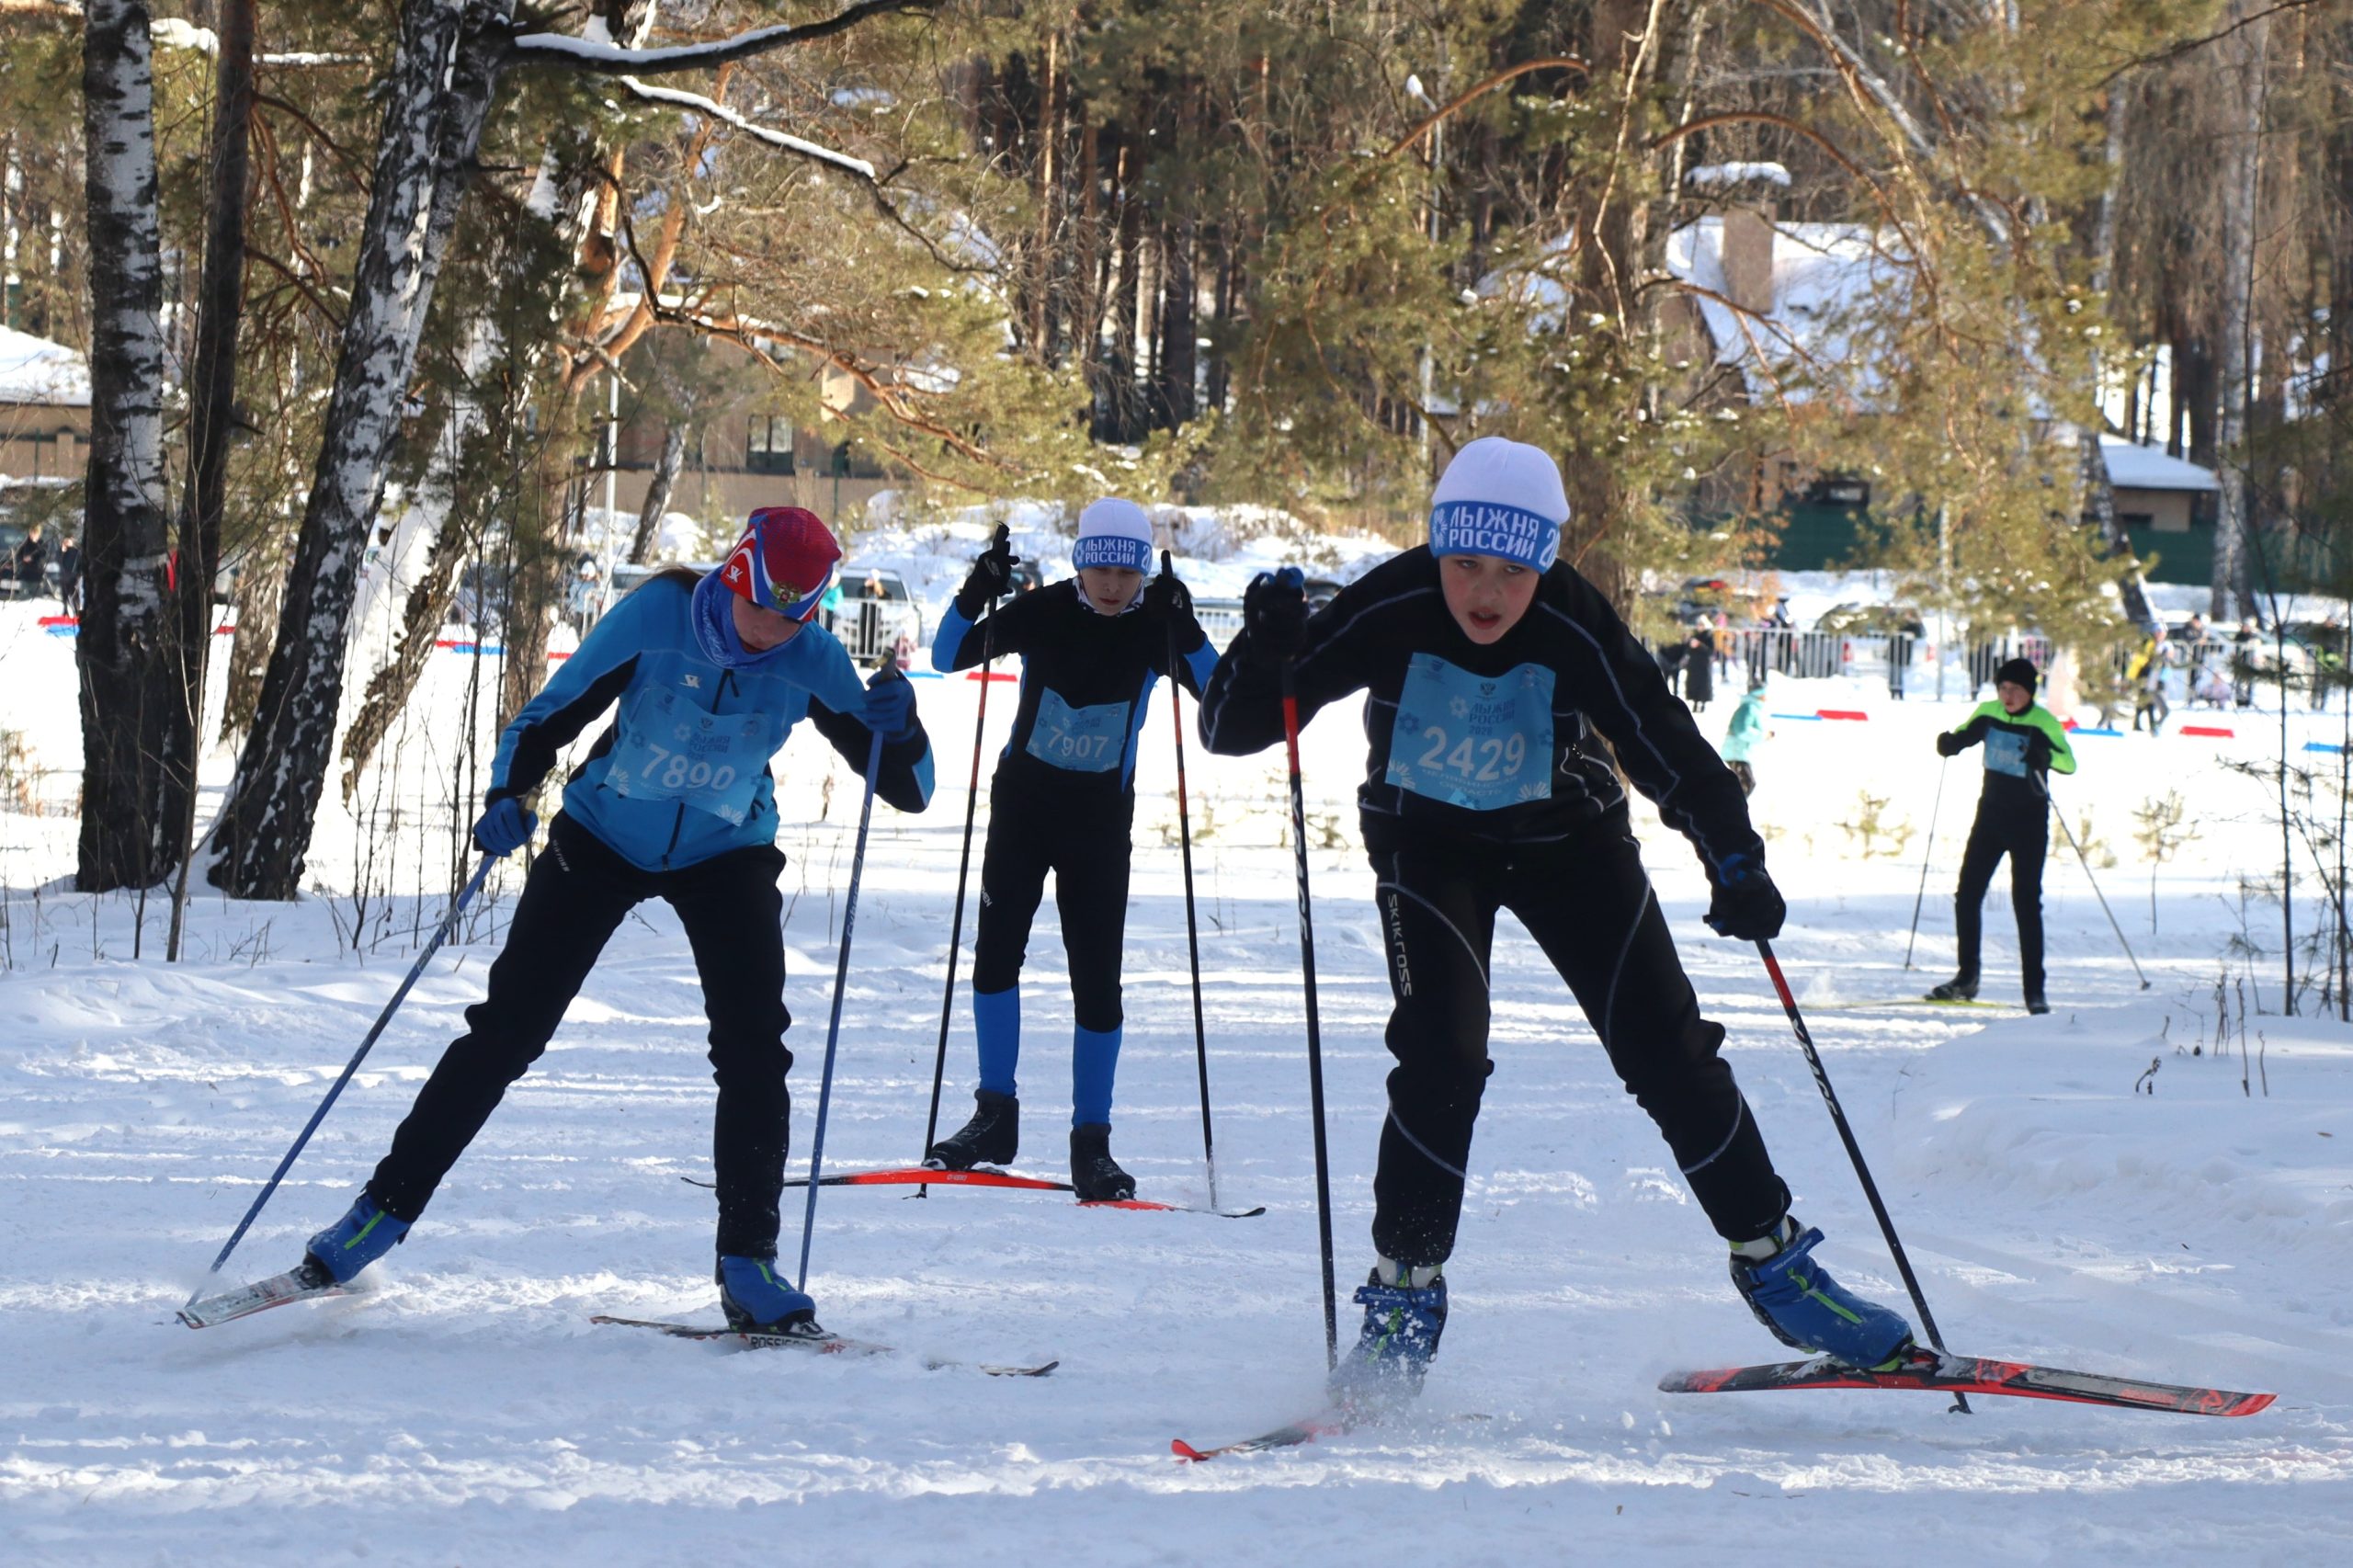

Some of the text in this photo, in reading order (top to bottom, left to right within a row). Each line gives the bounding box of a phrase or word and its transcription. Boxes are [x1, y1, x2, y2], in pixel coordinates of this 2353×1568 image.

[1449, 506, 1540, 539] ЛЫЖНЯ
[1086, 539, 1136, 553] ЛЫЖНЯ
[1086, 551, 1135, 565] РОССИИ
[1449, 529, 1536, 560] РОССИИ
[1048, 726, 1109, 758] 7907
[1417, 726, 1526, 781] 2429
[642, 743, 735, 790] 7890
